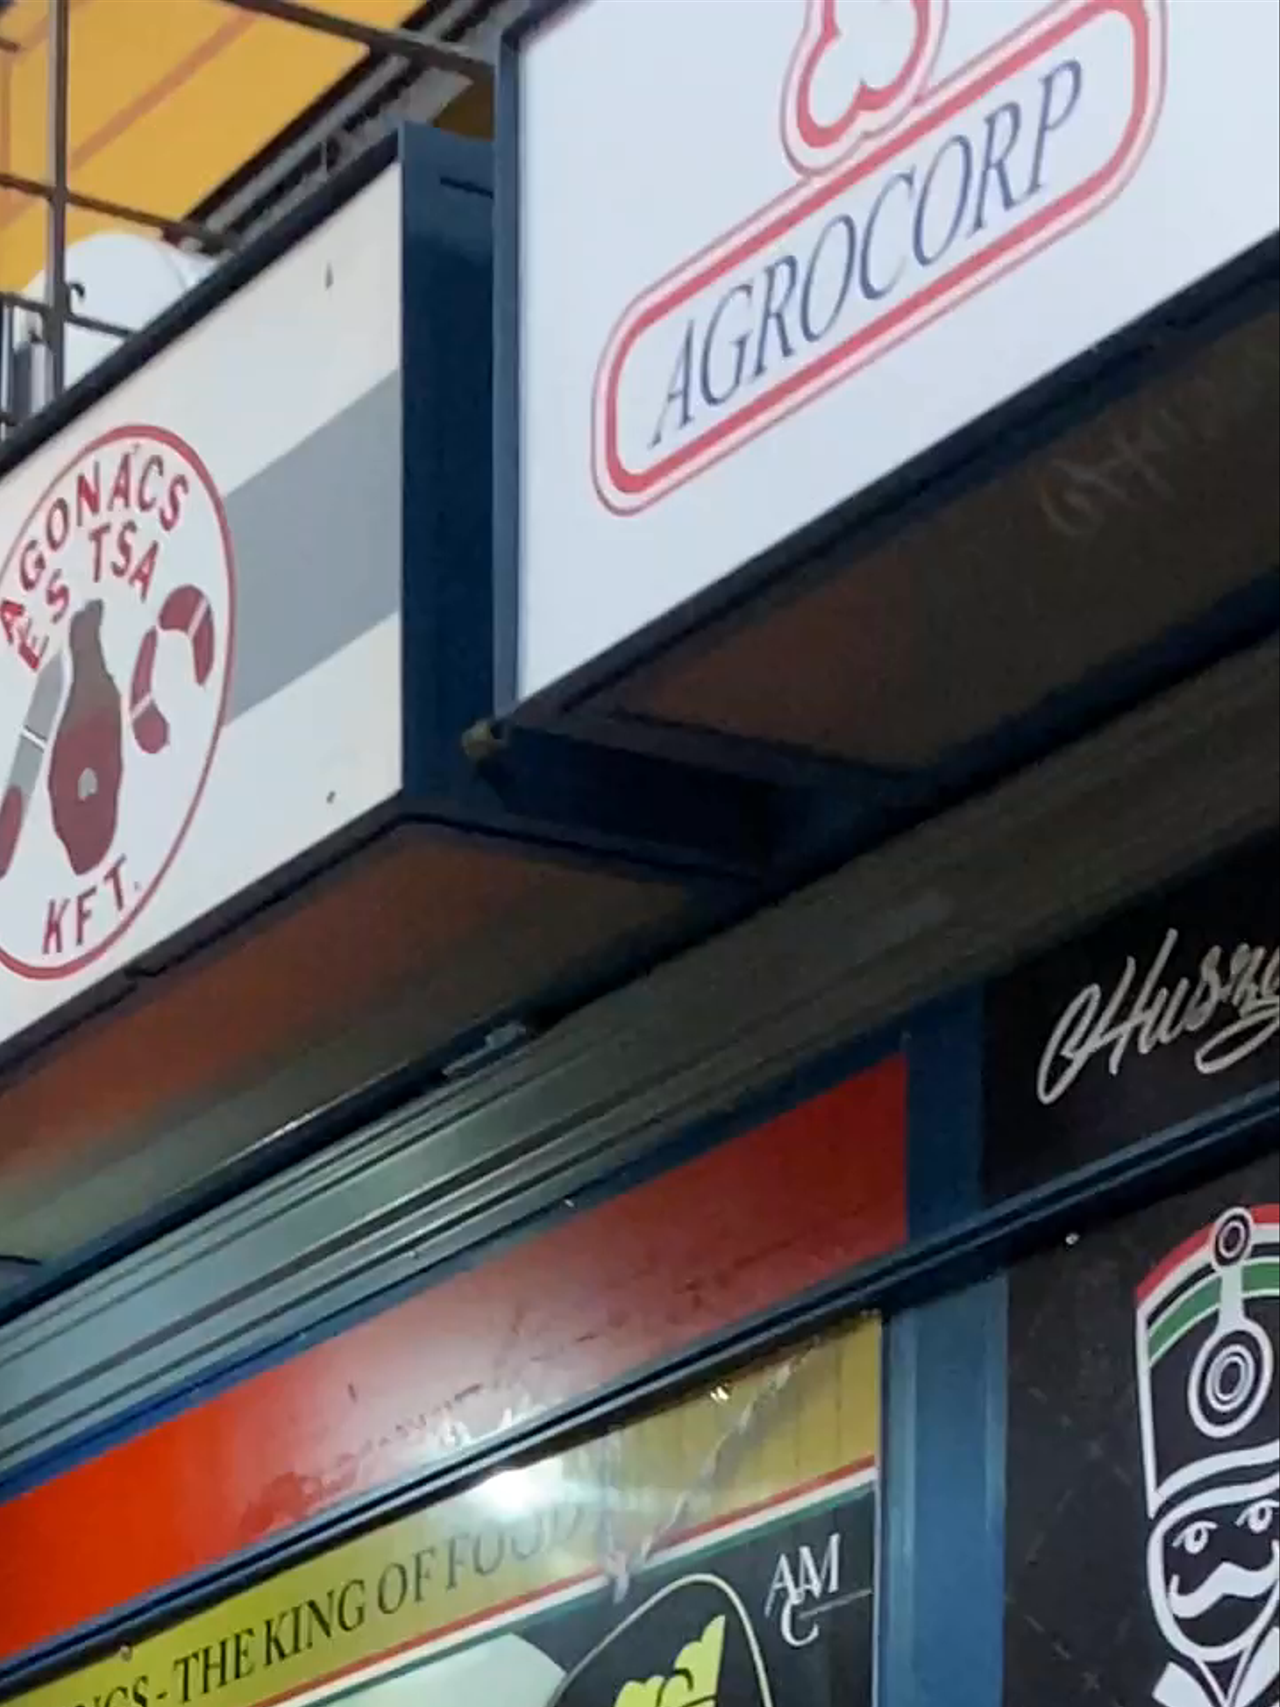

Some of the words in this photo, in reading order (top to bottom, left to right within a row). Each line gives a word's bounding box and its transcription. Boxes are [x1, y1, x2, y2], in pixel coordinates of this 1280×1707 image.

[648, 58, 1083, 450] AGROCORP
[88, 520, 160, 602] TSA
[173, 1636, 255, 1707] THE
[265, 1578, 366, 1671] KING
[378, 1548, 436, 1620] OF
